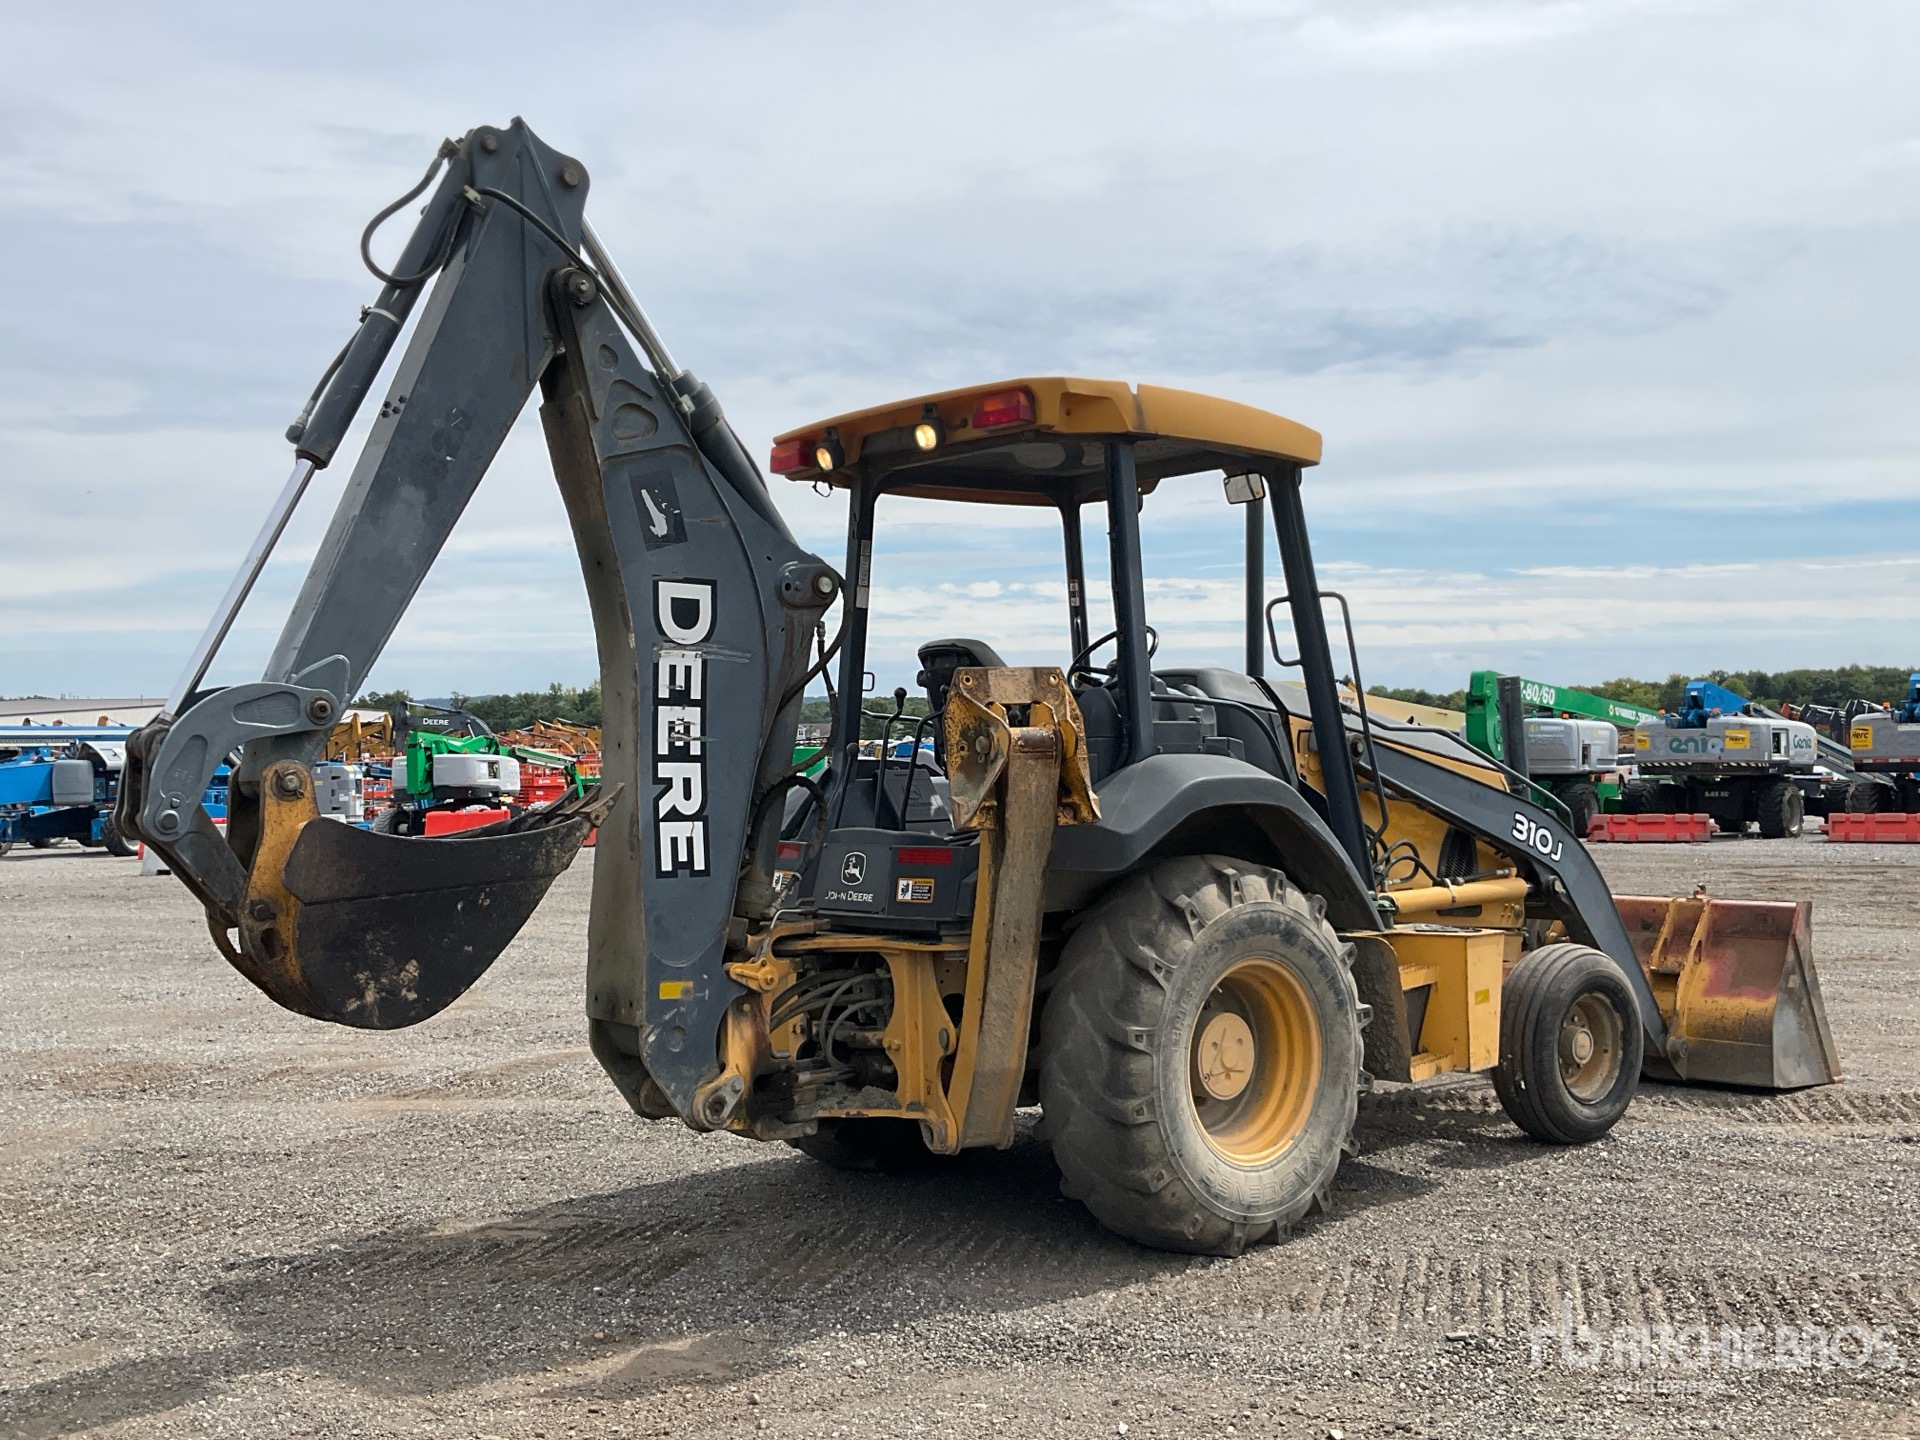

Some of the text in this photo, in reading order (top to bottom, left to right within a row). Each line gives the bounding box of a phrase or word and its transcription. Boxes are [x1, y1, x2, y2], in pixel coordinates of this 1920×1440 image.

[422, 717, 450, 726] DEERE
[657, 580, 712, 873] DEERE
[1511, 812, 1563, 861] 310J
[847, 890, 874, 902] DEERE
